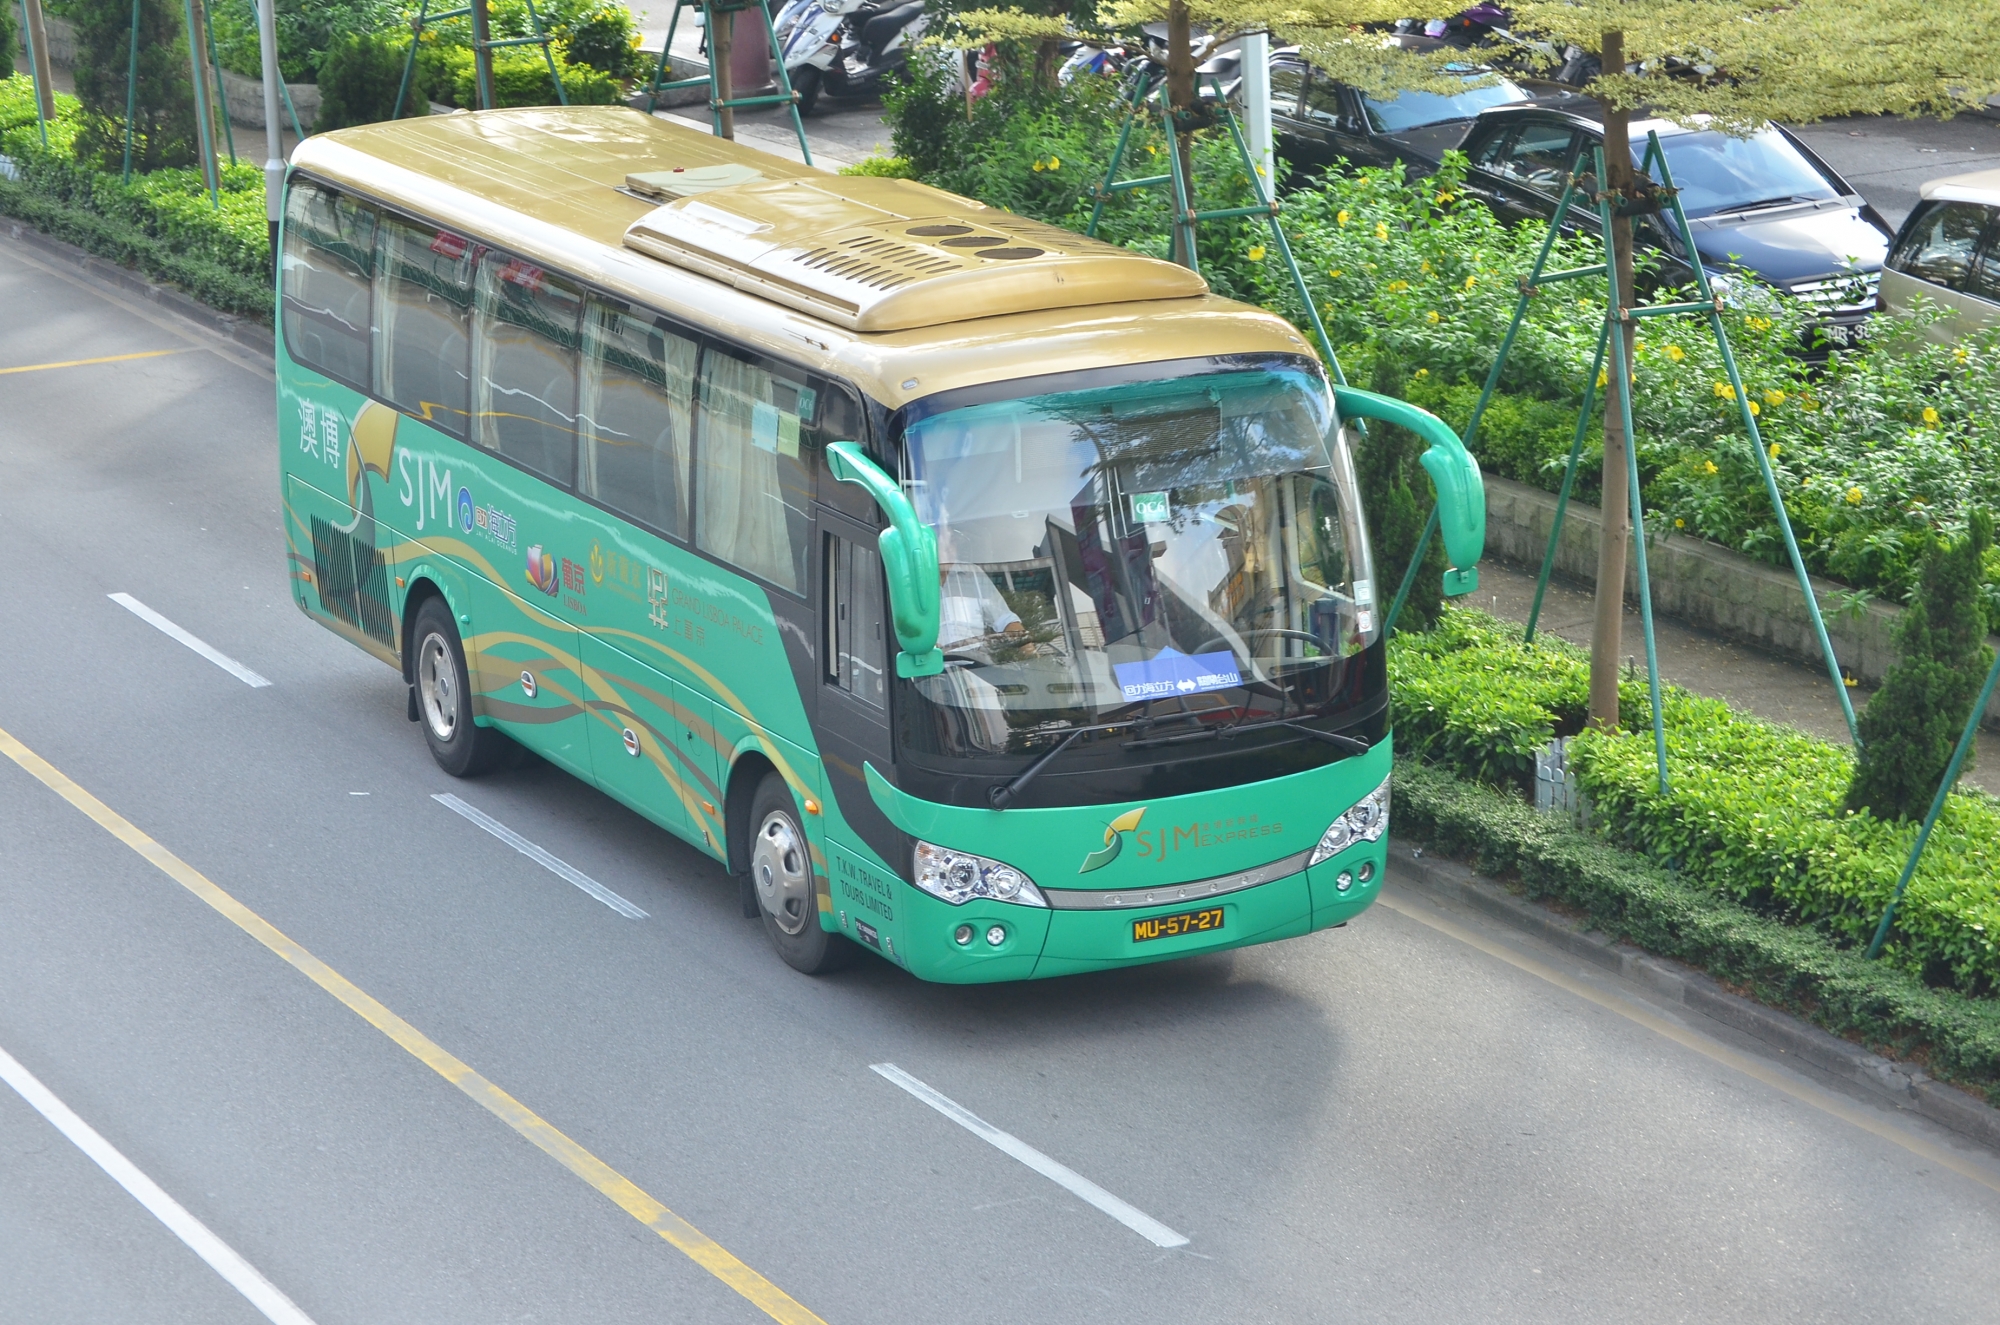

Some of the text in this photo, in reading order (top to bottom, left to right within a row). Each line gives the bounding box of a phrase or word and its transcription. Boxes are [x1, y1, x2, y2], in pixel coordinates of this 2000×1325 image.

[298, 397, 340, 469] 澳博
[398, 447, 453, 531] SJM
[1135, 500, 1165, 515] OC6
[562, 557, 586, 596] 葡京
[563, 593, 588, 617] LISBOA
[671, 587, 701, 615] GRAND
[702, 601, 730, 627] LISBOA
[732, 615, 764, 646] PALACE
[1135, 821, 1200, 863] SJM
[1201, 822, 1283, 847] EXPRESS
[840, 879, 894, 922] TOURS LIMITED
[858, 867, 886, 897] TRAVEL
[886, 884, 893, 900] &
[1134, 909, 1223, 940] MU-57-27
